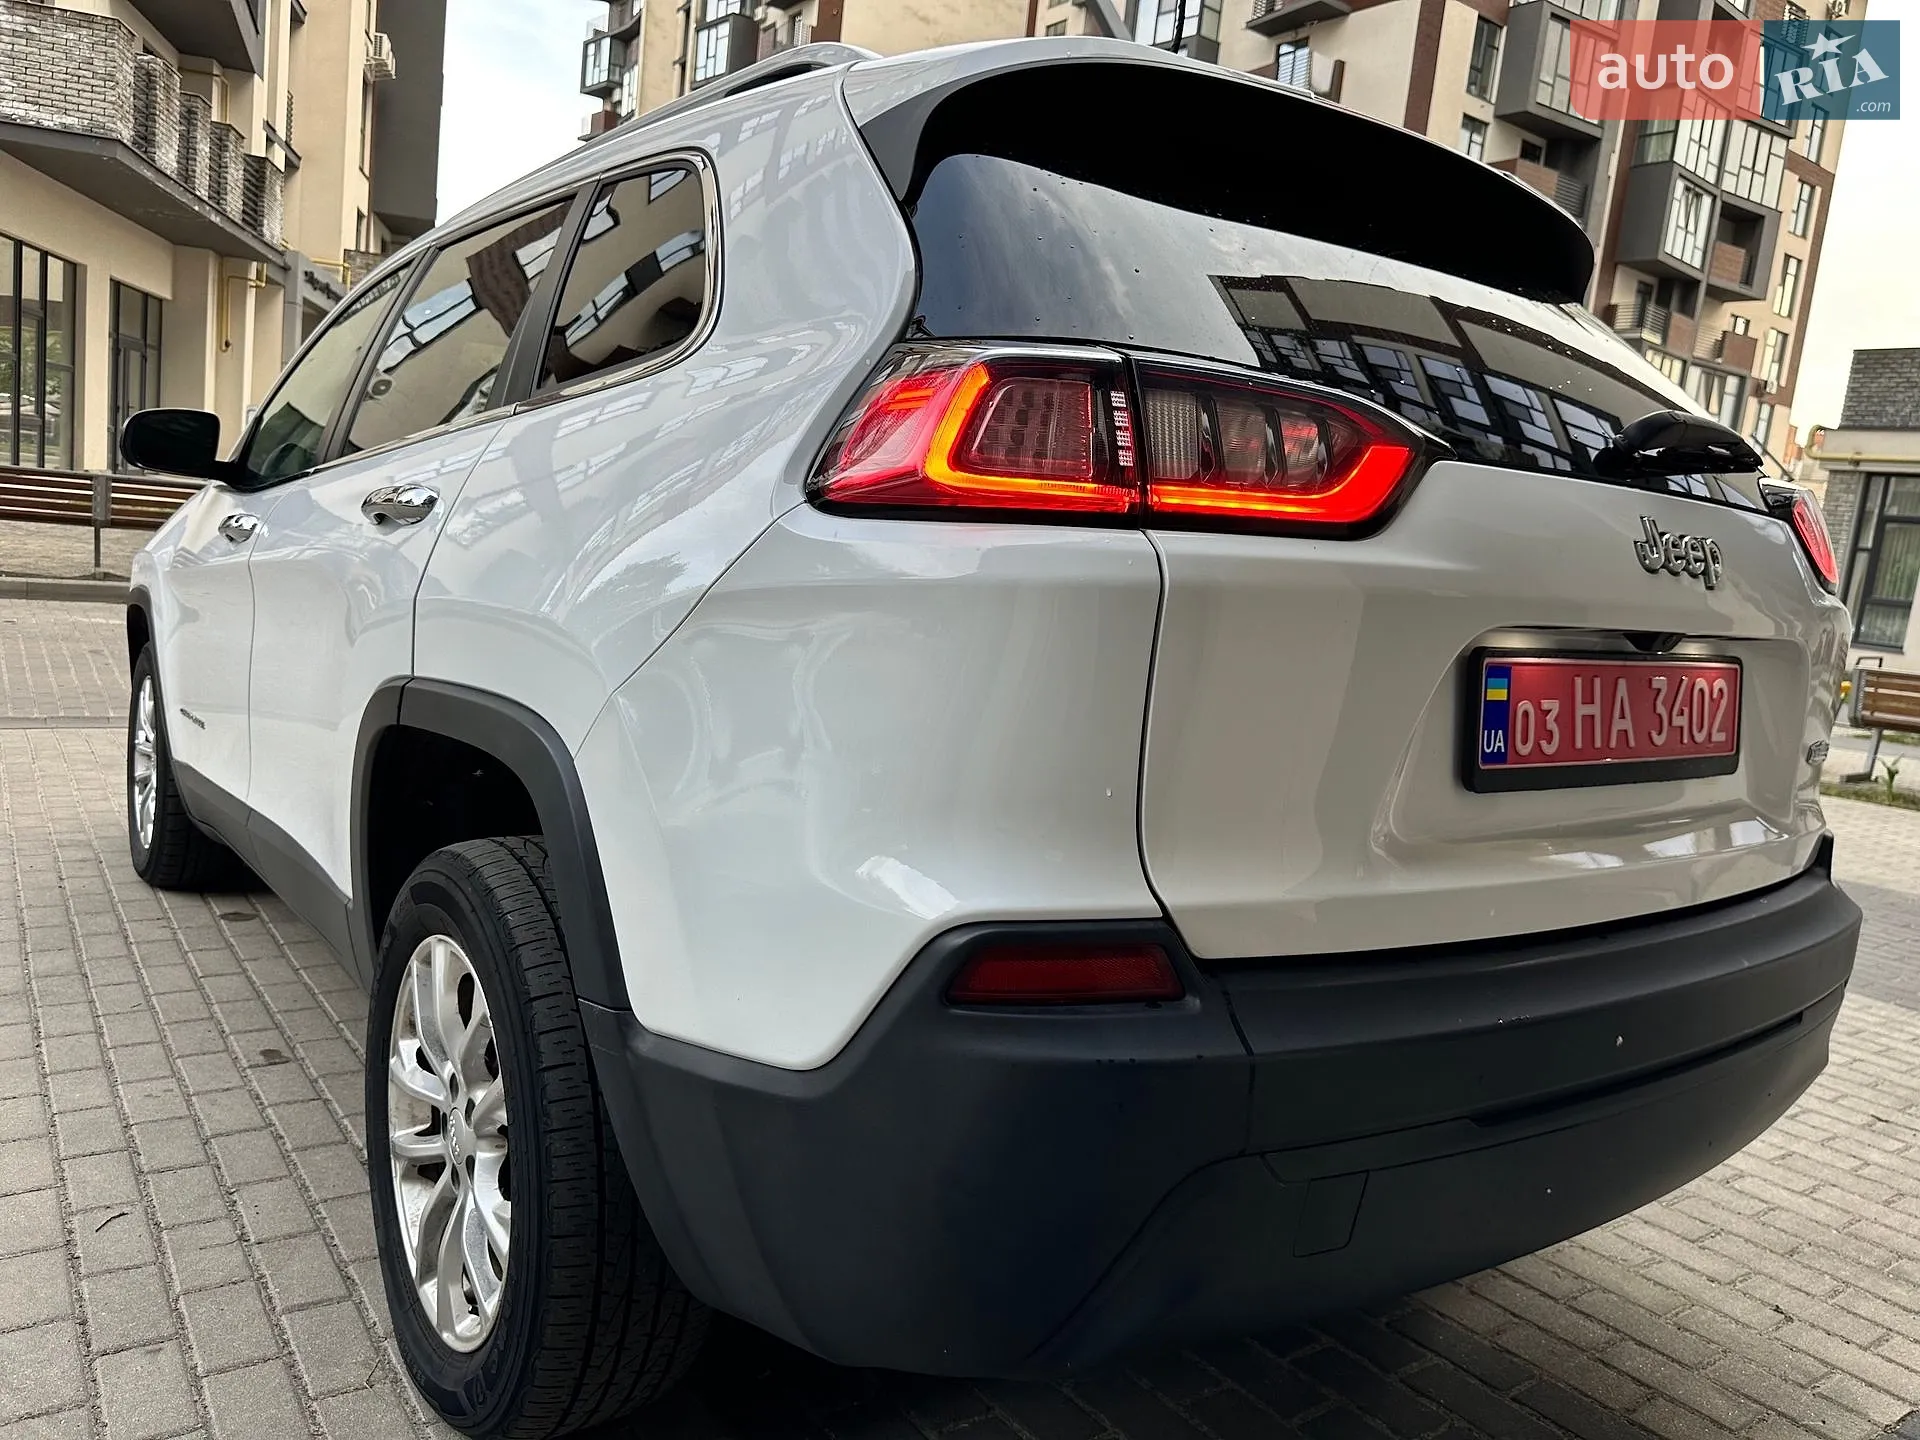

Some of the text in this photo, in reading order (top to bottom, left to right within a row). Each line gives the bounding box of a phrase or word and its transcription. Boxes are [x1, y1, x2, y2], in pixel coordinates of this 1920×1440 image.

[1633, 515, 1722, 591] Jeep
[1483, 729, 1506, 753] UA
[1514, 674, 1729, 757] 03 HA 3402
